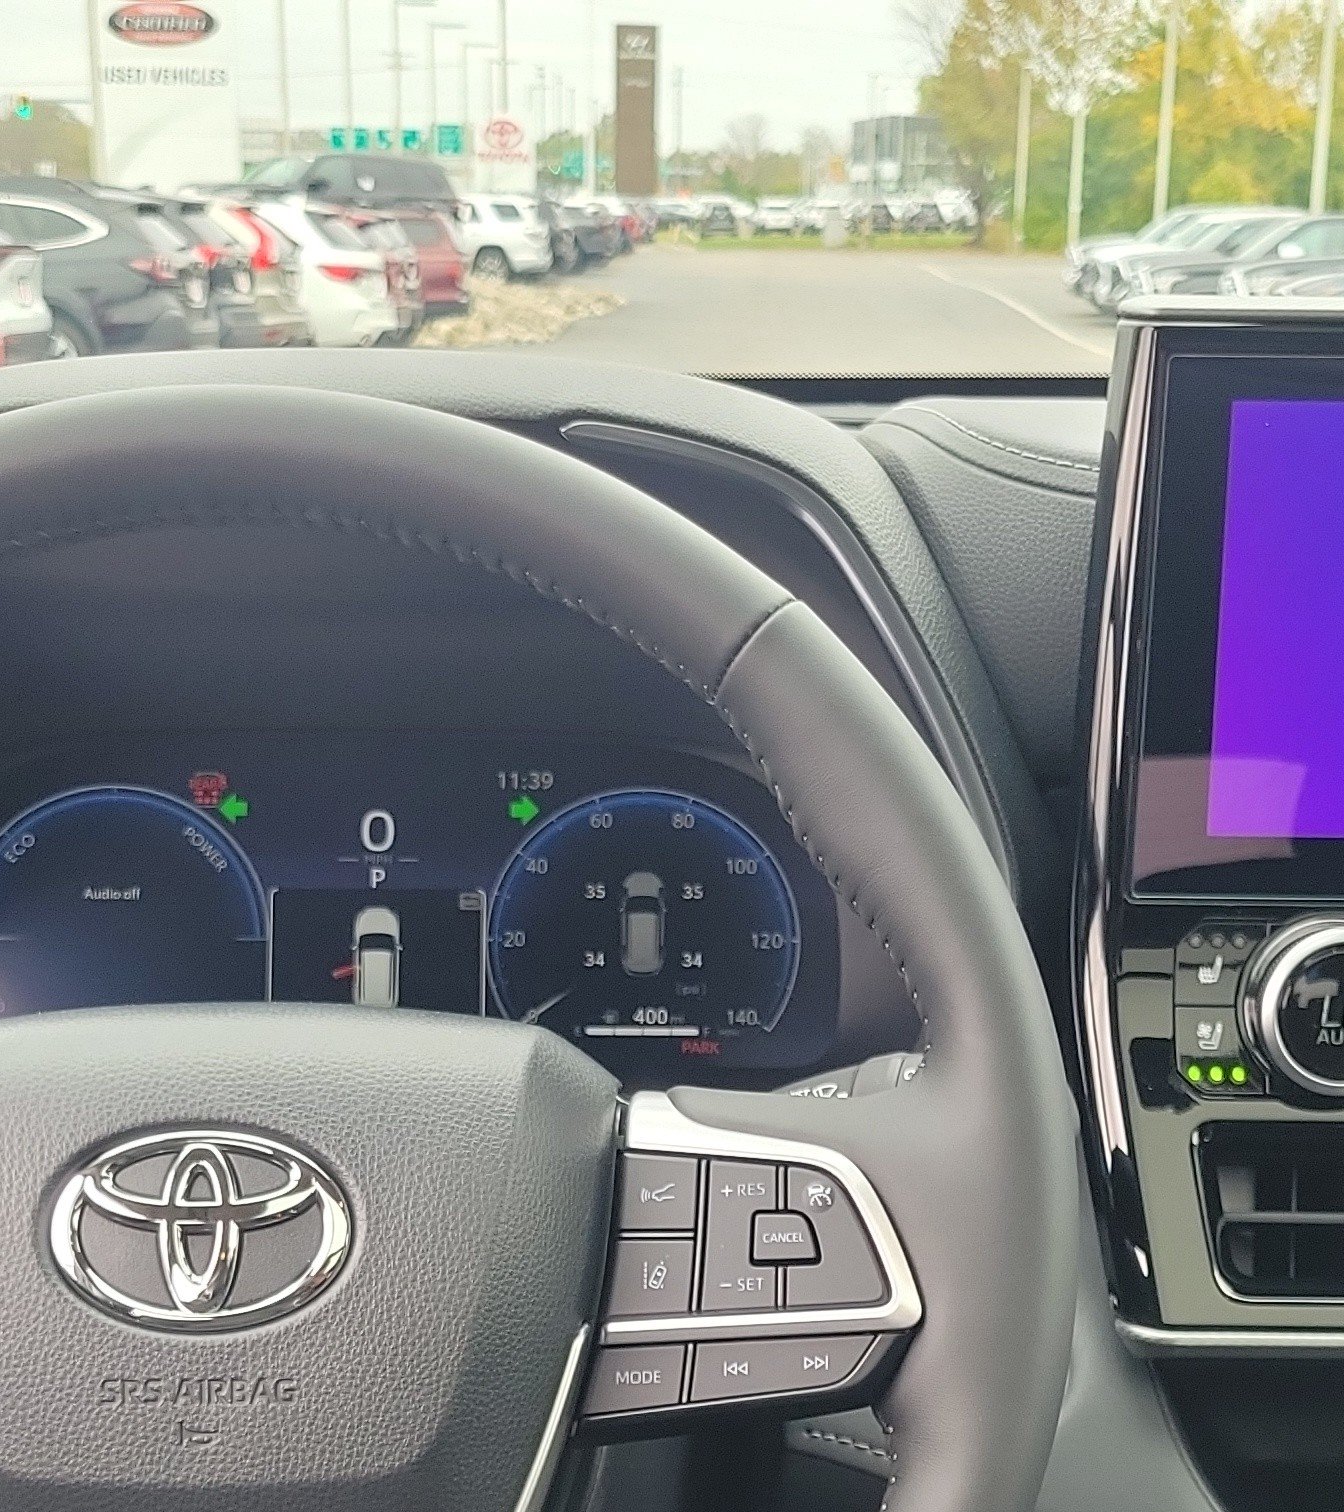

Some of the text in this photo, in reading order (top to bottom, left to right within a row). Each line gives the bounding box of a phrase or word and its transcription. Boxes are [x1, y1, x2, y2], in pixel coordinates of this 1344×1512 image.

[497, 772, 555, 791] 11:39
[589, 813, 613, 829] 60
[672, 813, 695, 830] 80
[360, 810, 396, 852] 0
[3, 833, 37, 864] ECO
[181, 826, 229, 873] POWER
[525, 858, 549, 875] 40
[726, 858, 757, 875] 100
[369, 868, 386, 889] P
[84, 887, 141, 900] Audio off
[583, 884, 606, 900] 35
[681, 884, 704, 900] 35
[504, 931, 526, 948] 20
[752, 932, 785, 949] 120
[583, 953, 606, 968] 34
[681, 953, 703, 968] 34
[632, 1006, 669, 1025] 400
[727, 1009, 758, 1026] 140
[762, 1232, 805, 1244] CANCEL
[615, 1370, 662, 1386] MODE
[99, 1377, 301, 1405] SRS AIRBAG
